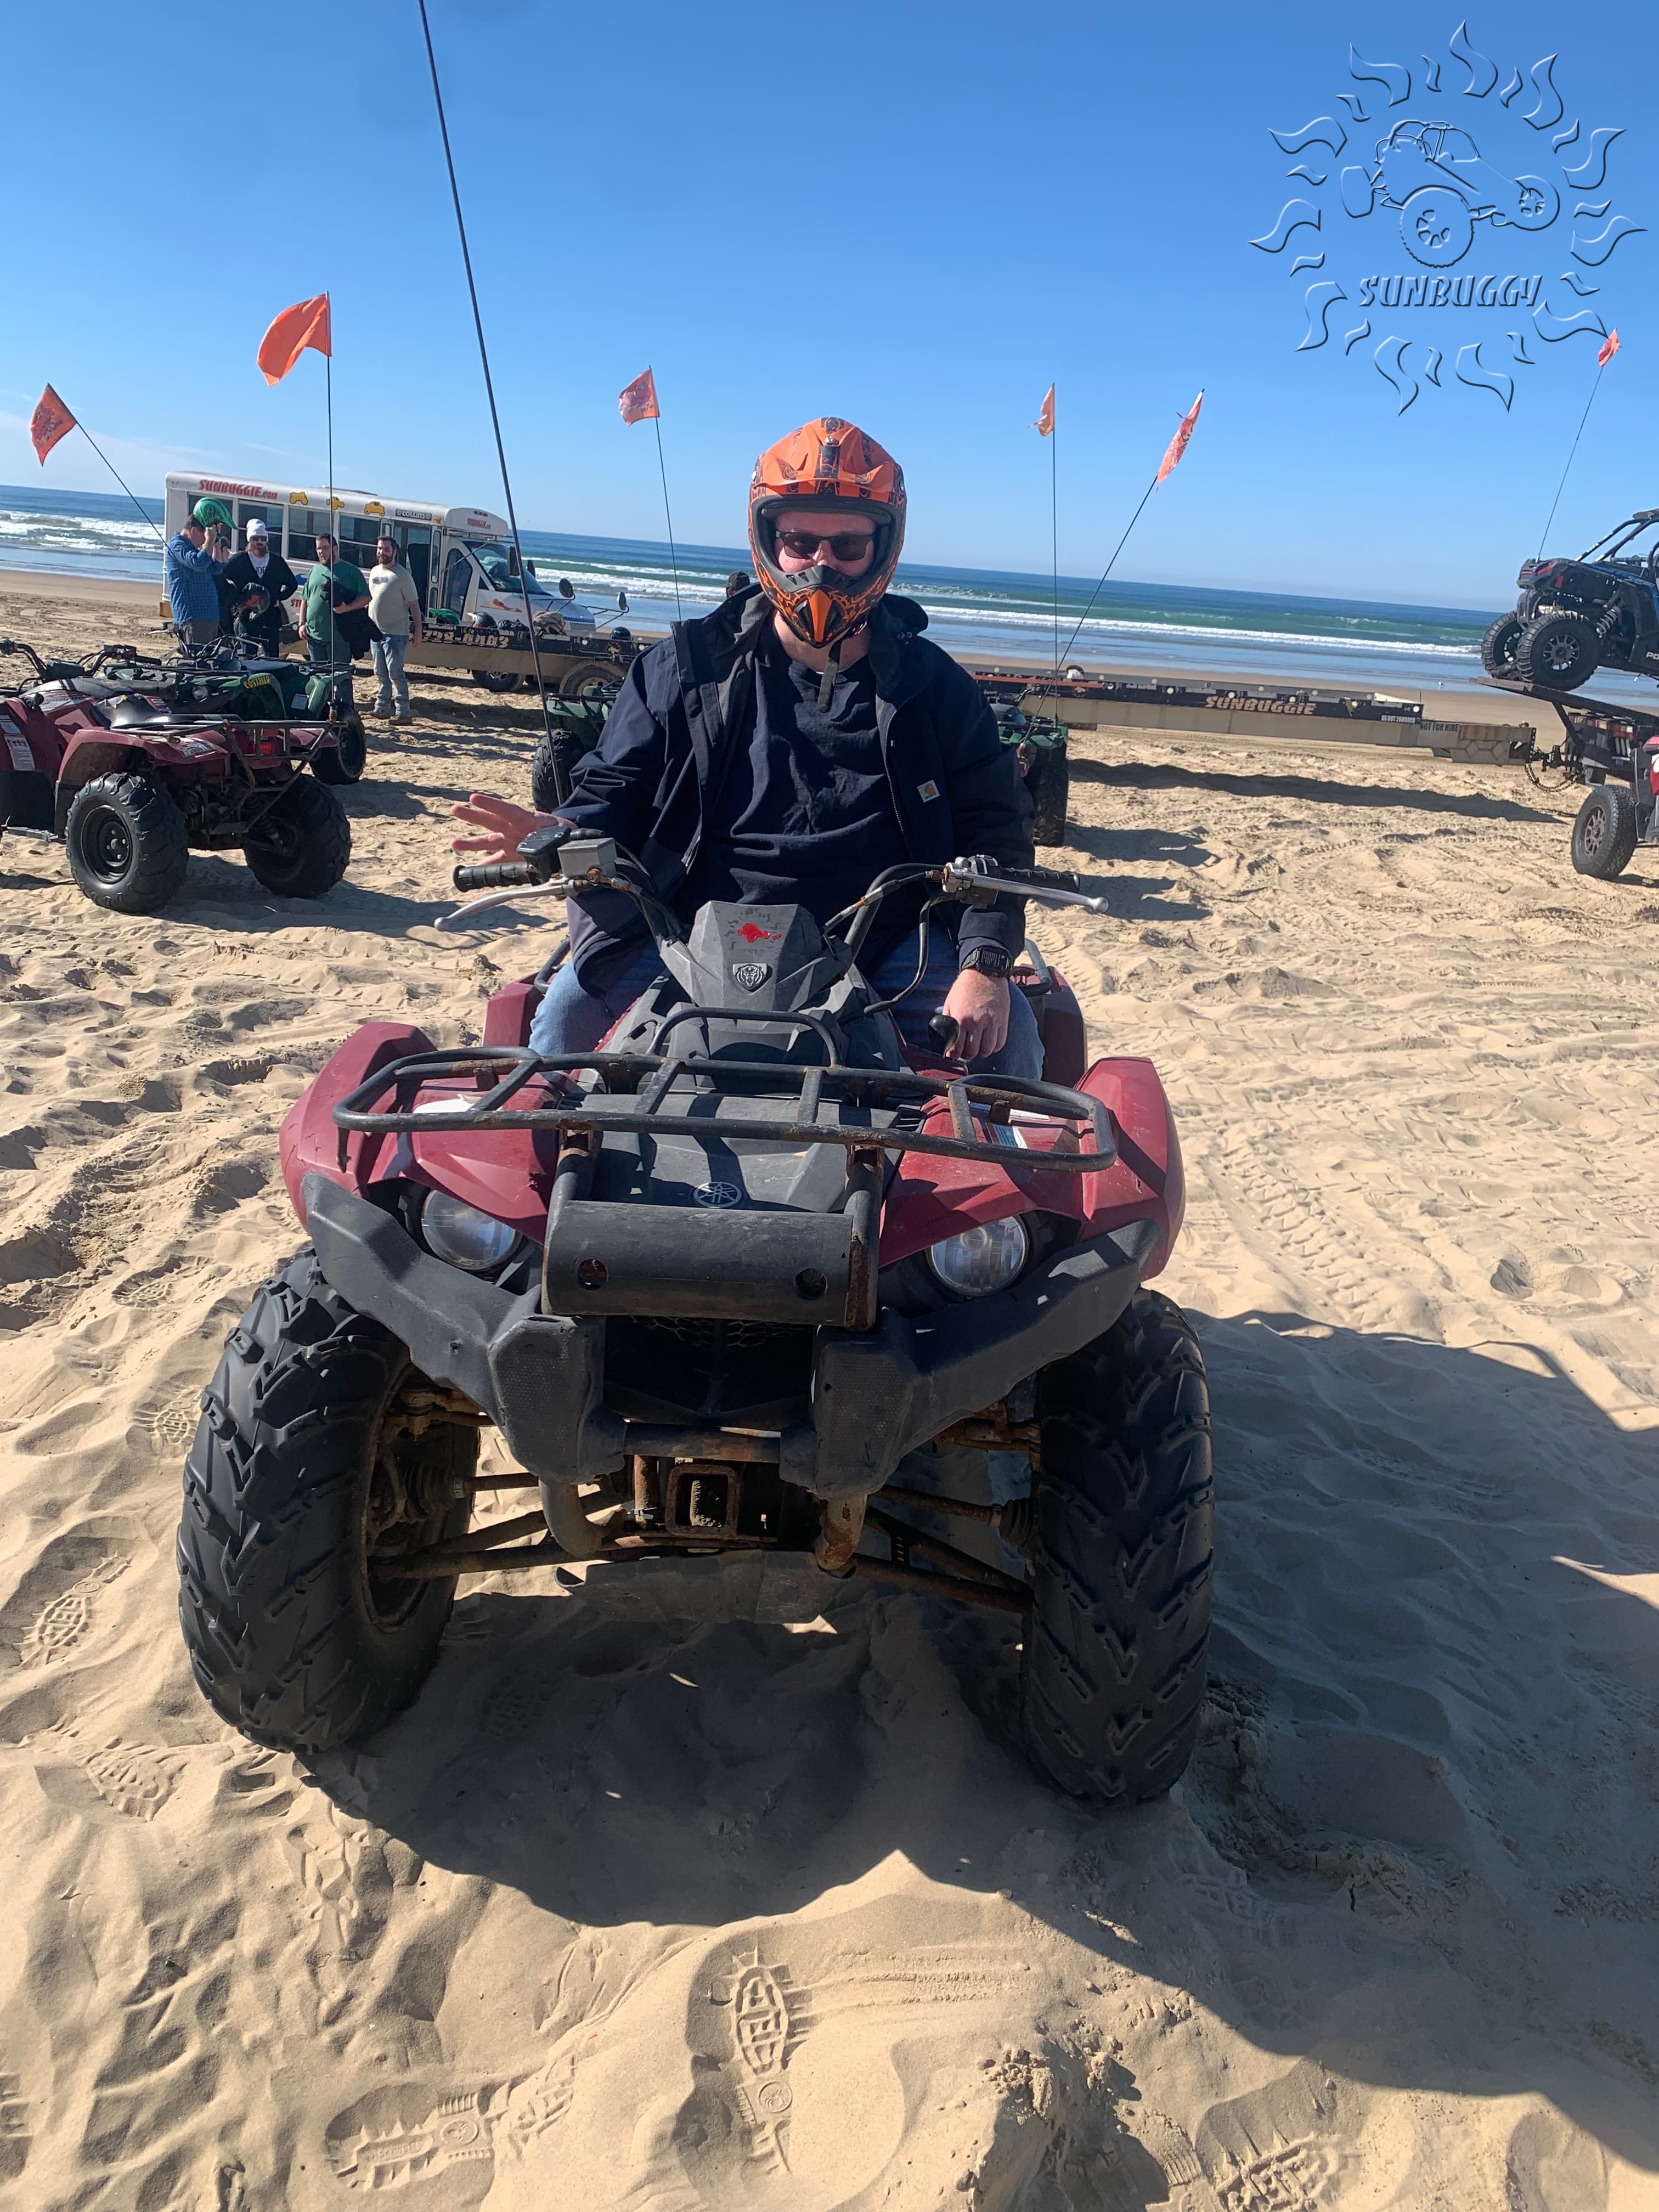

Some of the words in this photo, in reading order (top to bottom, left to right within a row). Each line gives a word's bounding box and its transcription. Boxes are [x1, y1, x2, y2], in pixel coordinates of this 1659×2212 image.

[1204, 696, 1317, 715] SUNBUGGIE
[1420, 722, 1431, 730] NOT
[1432, 723, 1444, 731] FOR
